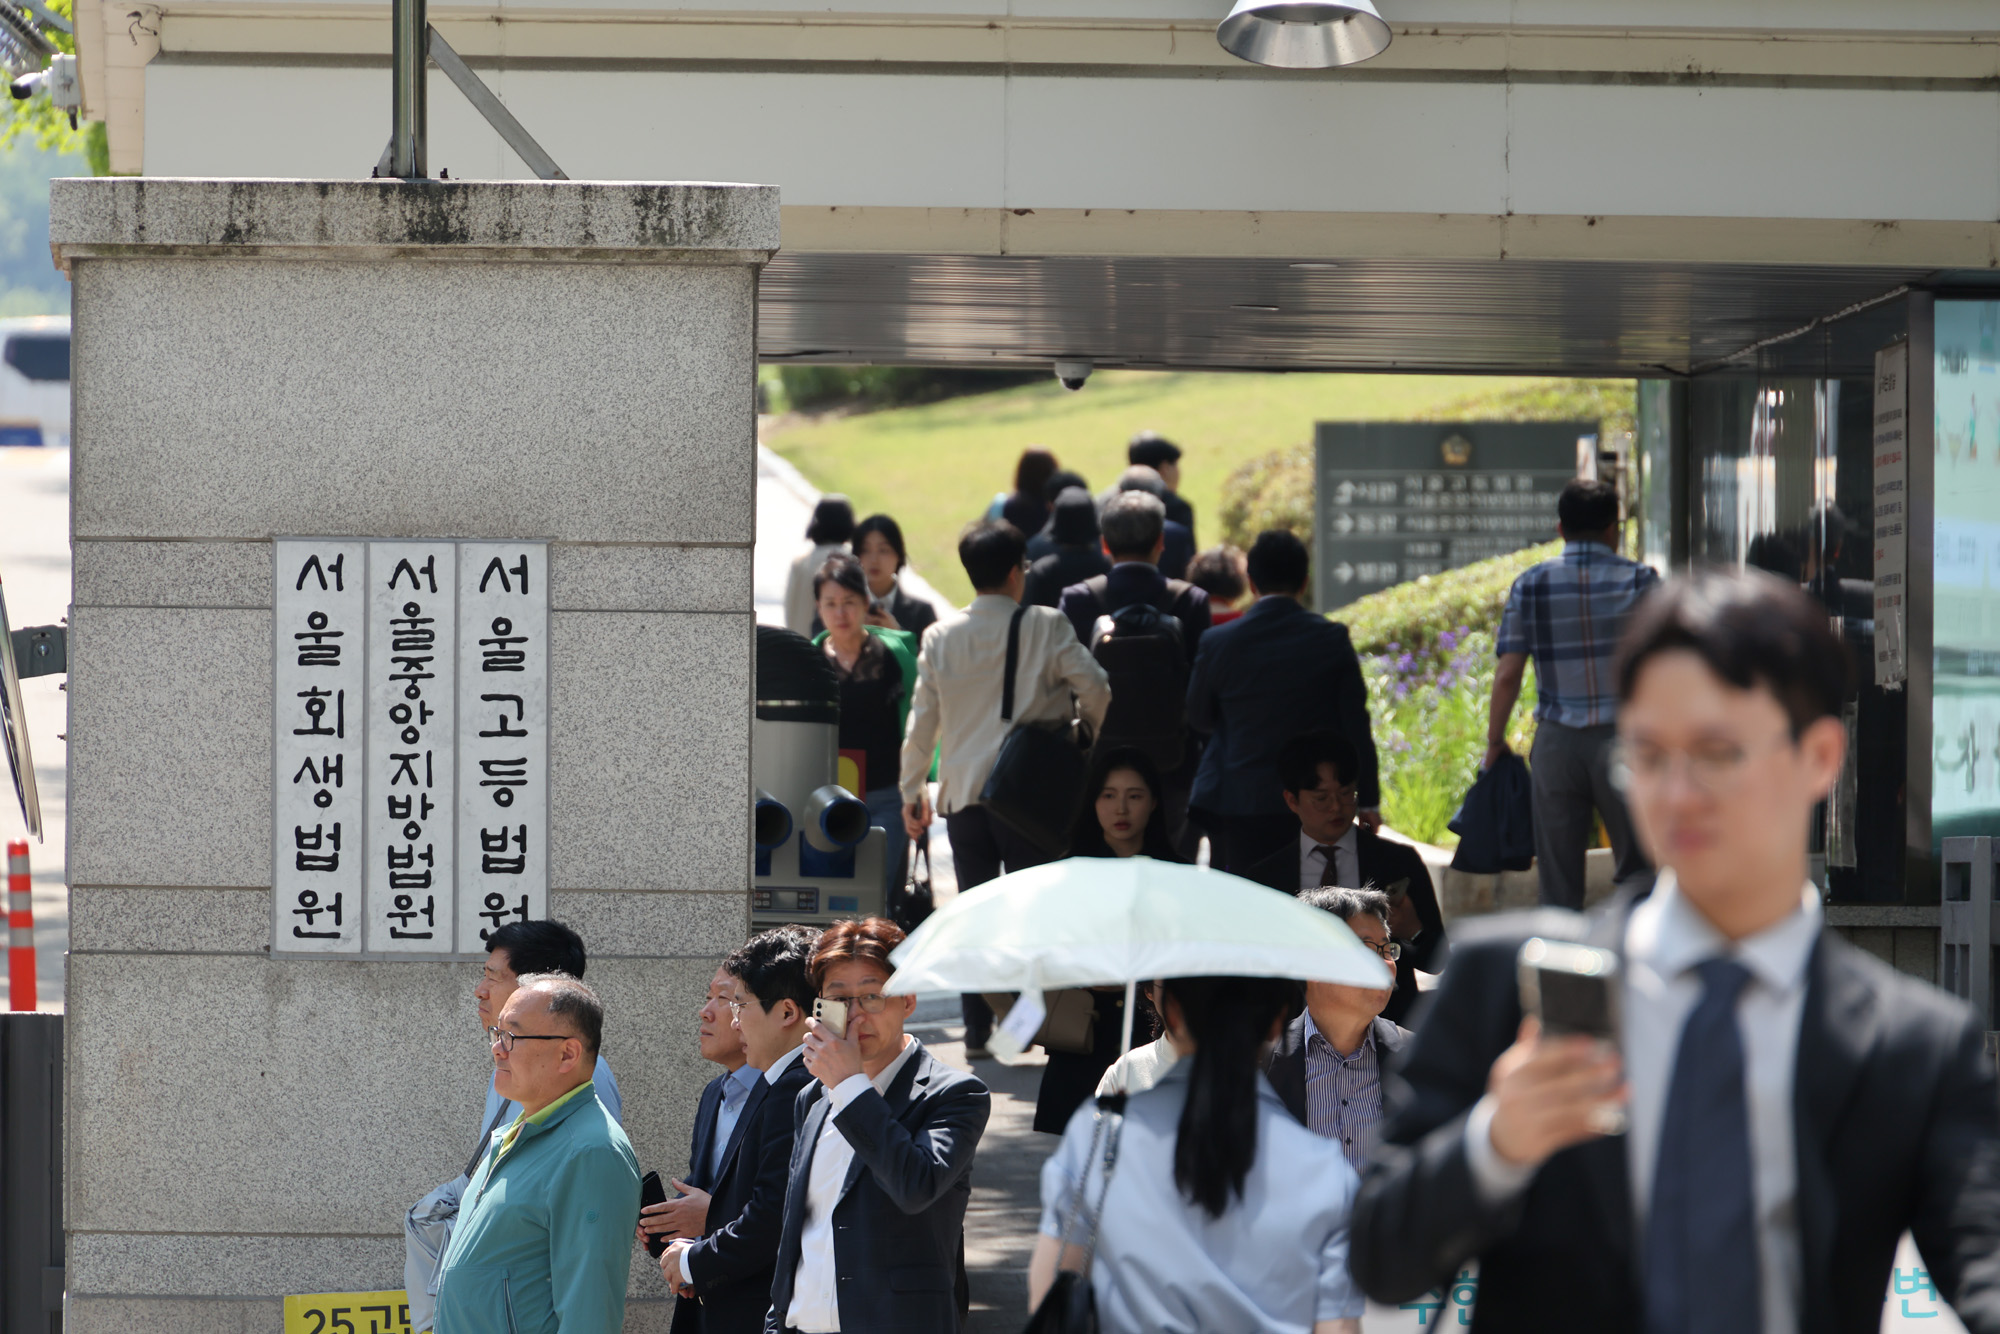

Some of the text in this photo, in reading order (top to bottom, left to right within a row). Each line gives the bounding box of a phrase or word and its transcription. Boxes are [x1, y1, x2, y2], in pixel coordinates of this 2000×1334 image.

[292, 553, 345, 940] 서울회생법원
[386, 554, 438, 940] 서울중앙지방법원
[478, 554, 529, 940] 서울고등법원
